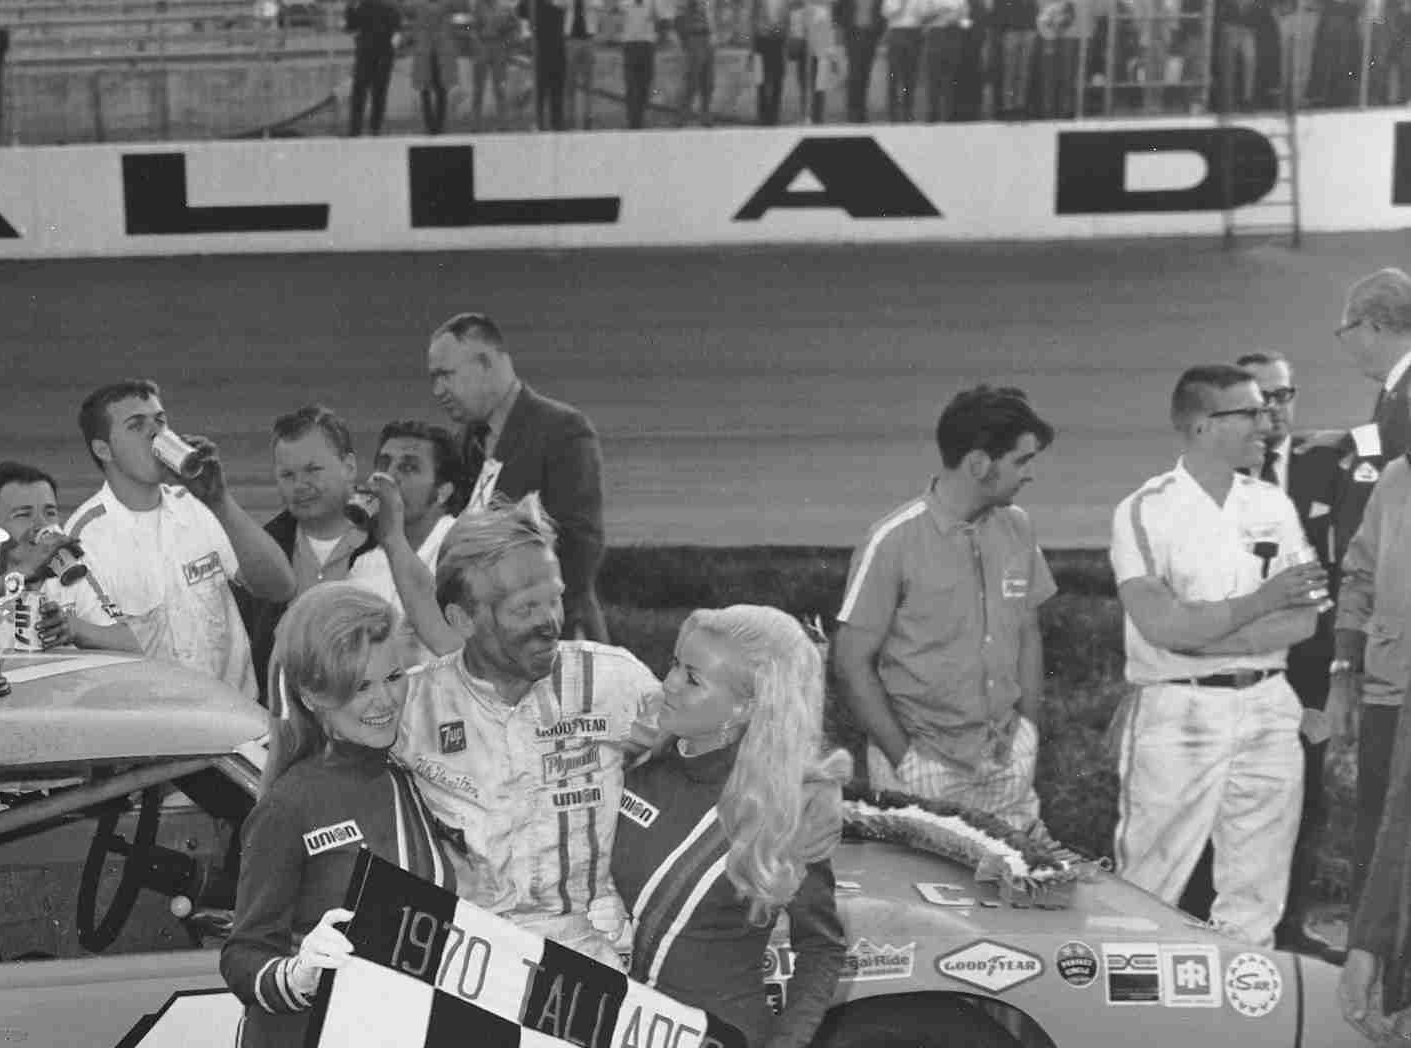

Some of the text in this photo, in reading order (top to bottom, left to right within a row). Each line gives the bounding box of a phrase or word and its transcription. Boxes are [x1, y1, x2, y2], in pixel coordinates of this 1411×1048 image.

[441, 726, 464, 749] 7up
[307, 825, 358, 850] union
[391, 906, 493, 1000] 1970
[944, 957, 1036, 975] GOODYEAR
